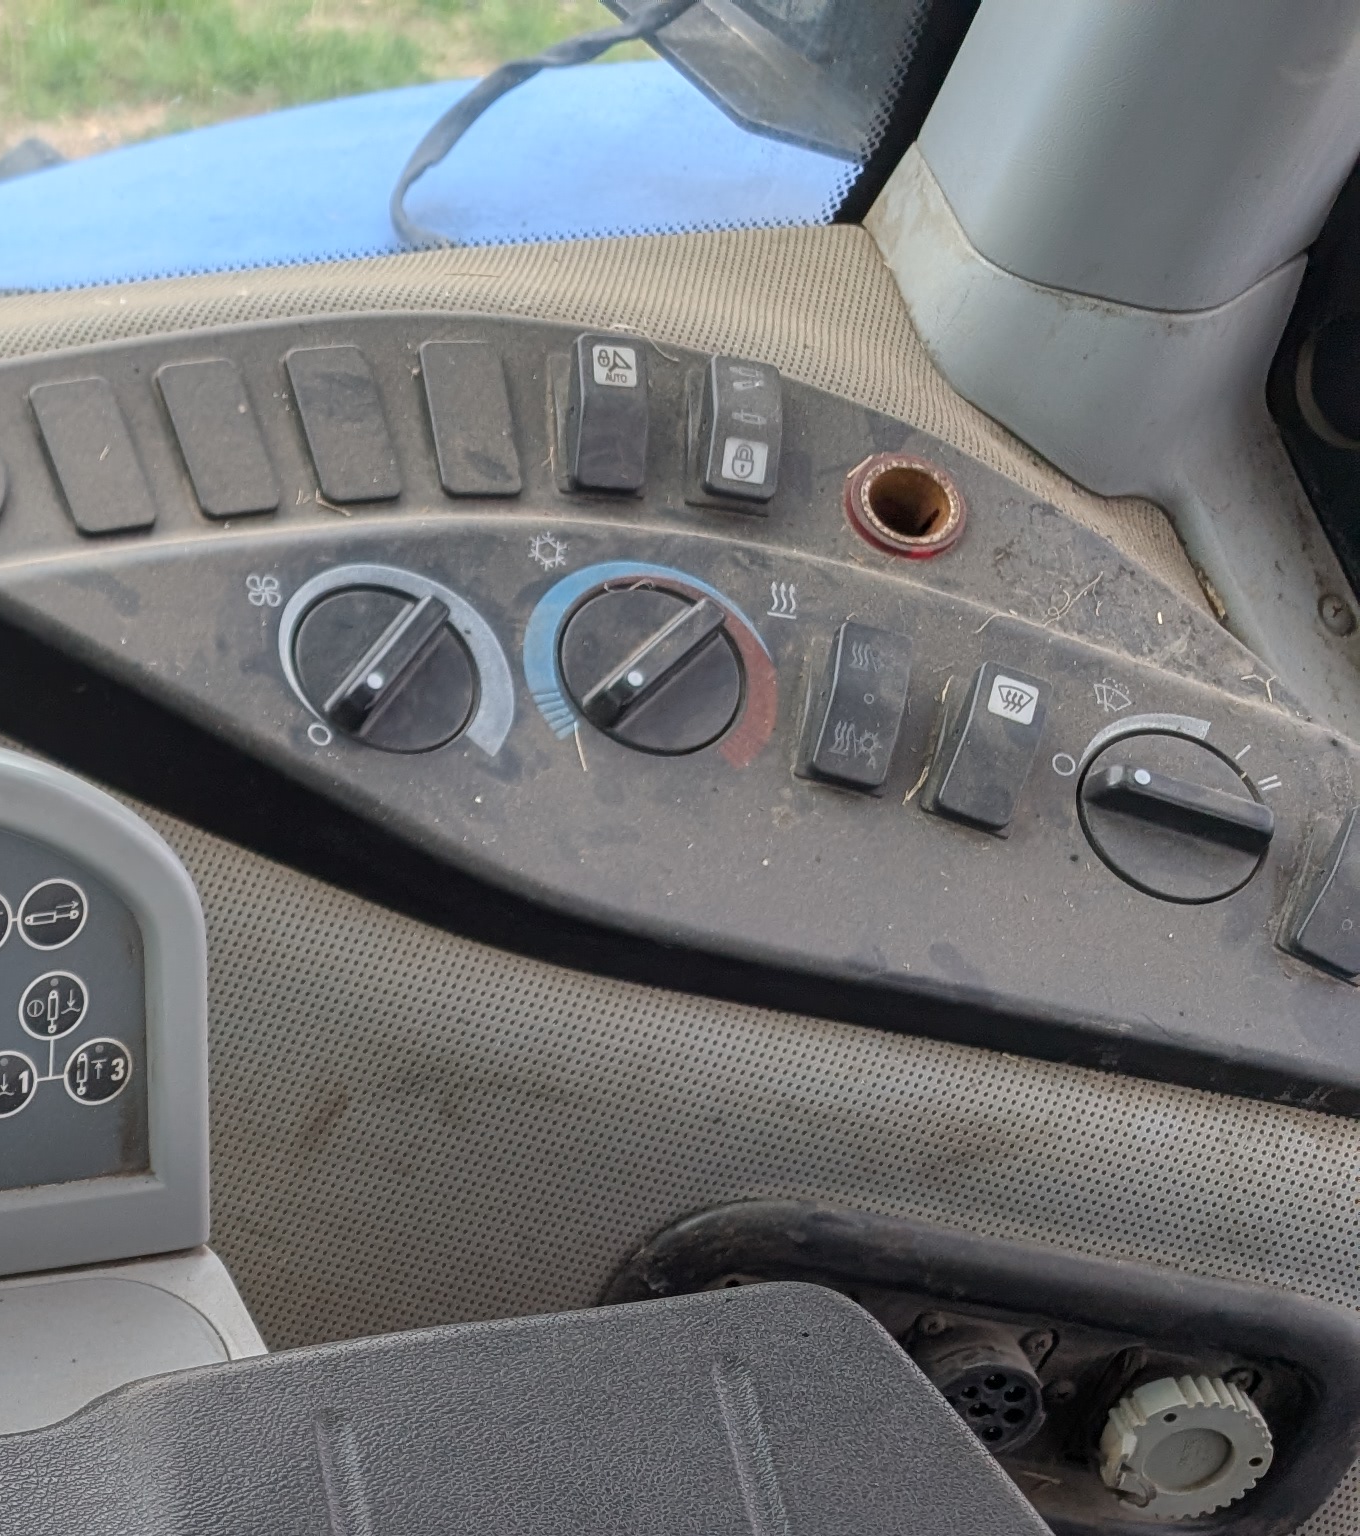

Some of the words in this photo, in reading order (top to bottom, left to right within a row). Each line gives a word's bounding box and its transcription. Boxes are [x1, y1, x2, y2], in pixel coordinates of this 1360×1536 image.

[605, 372, 627, 383] AUTO
[110, 1058, 125, 1081] 3
[18, 1070, 29, 1094] 1
